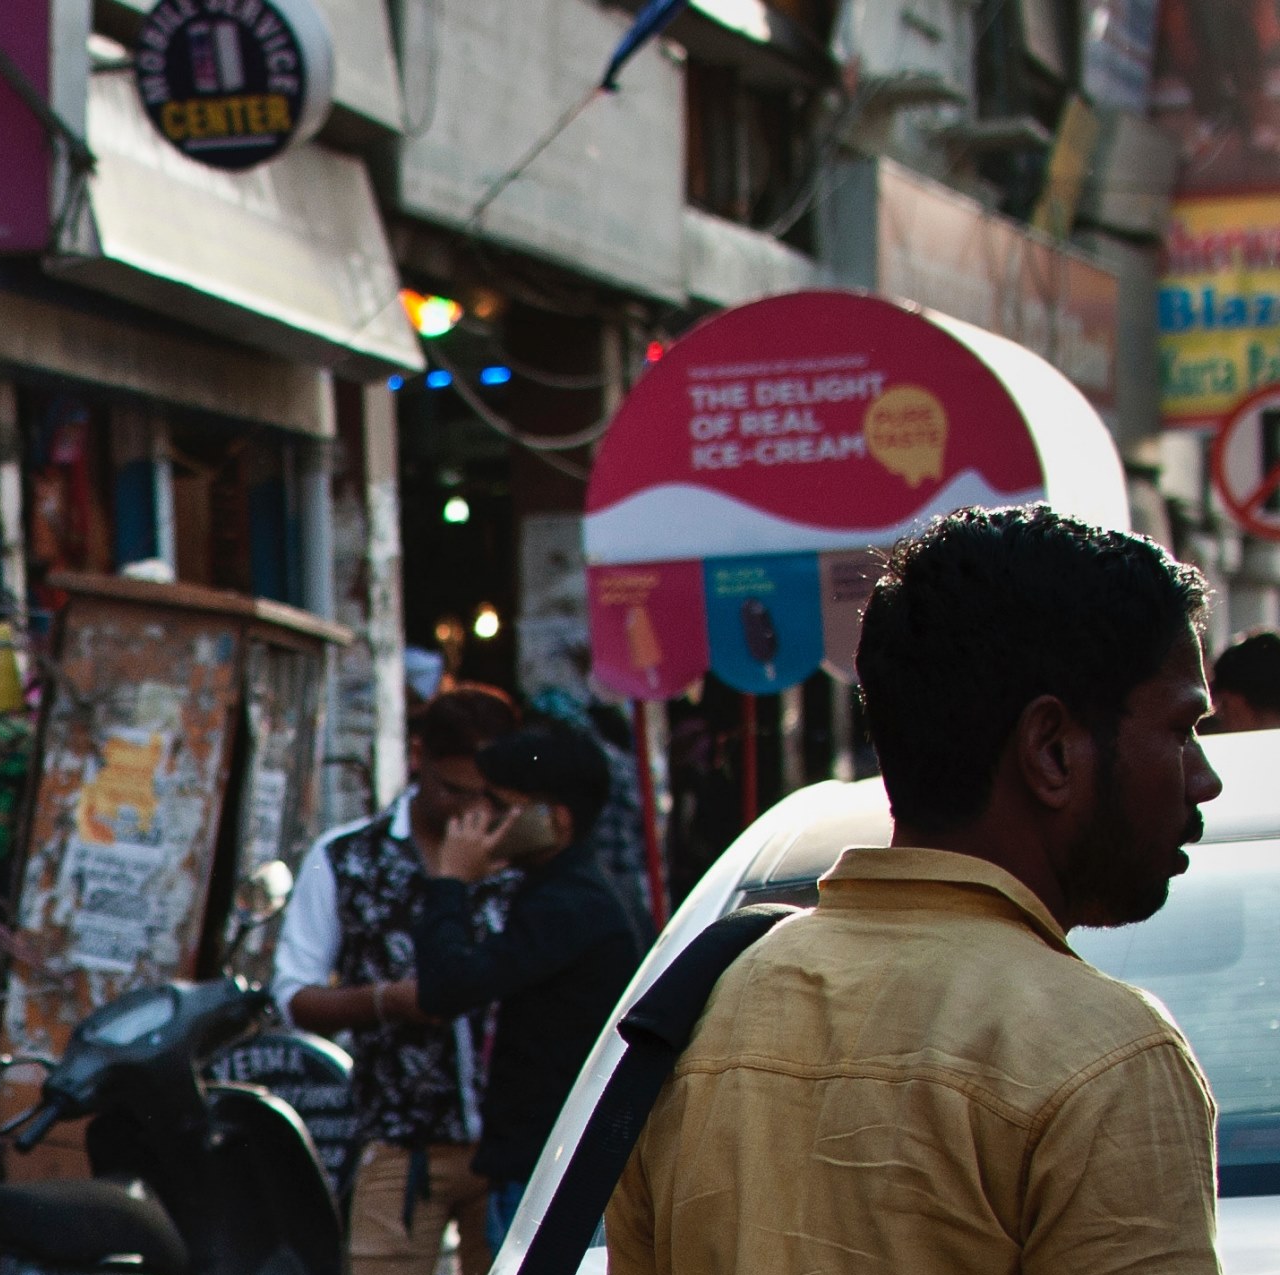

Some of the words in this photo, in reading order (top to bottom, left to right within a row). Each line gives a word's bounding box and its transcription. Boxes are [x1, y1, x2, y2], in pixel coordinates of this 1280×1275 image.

[159, 94, 295, 141] CENTER
[688, 384, 748, 412] THE
[752, 370, 886, 408] DELIGHT
[689, 411, 733, 441] OF
[738, 407, 824, 438] REAL
[690, 433, 868, 470] ICE-CREAM
